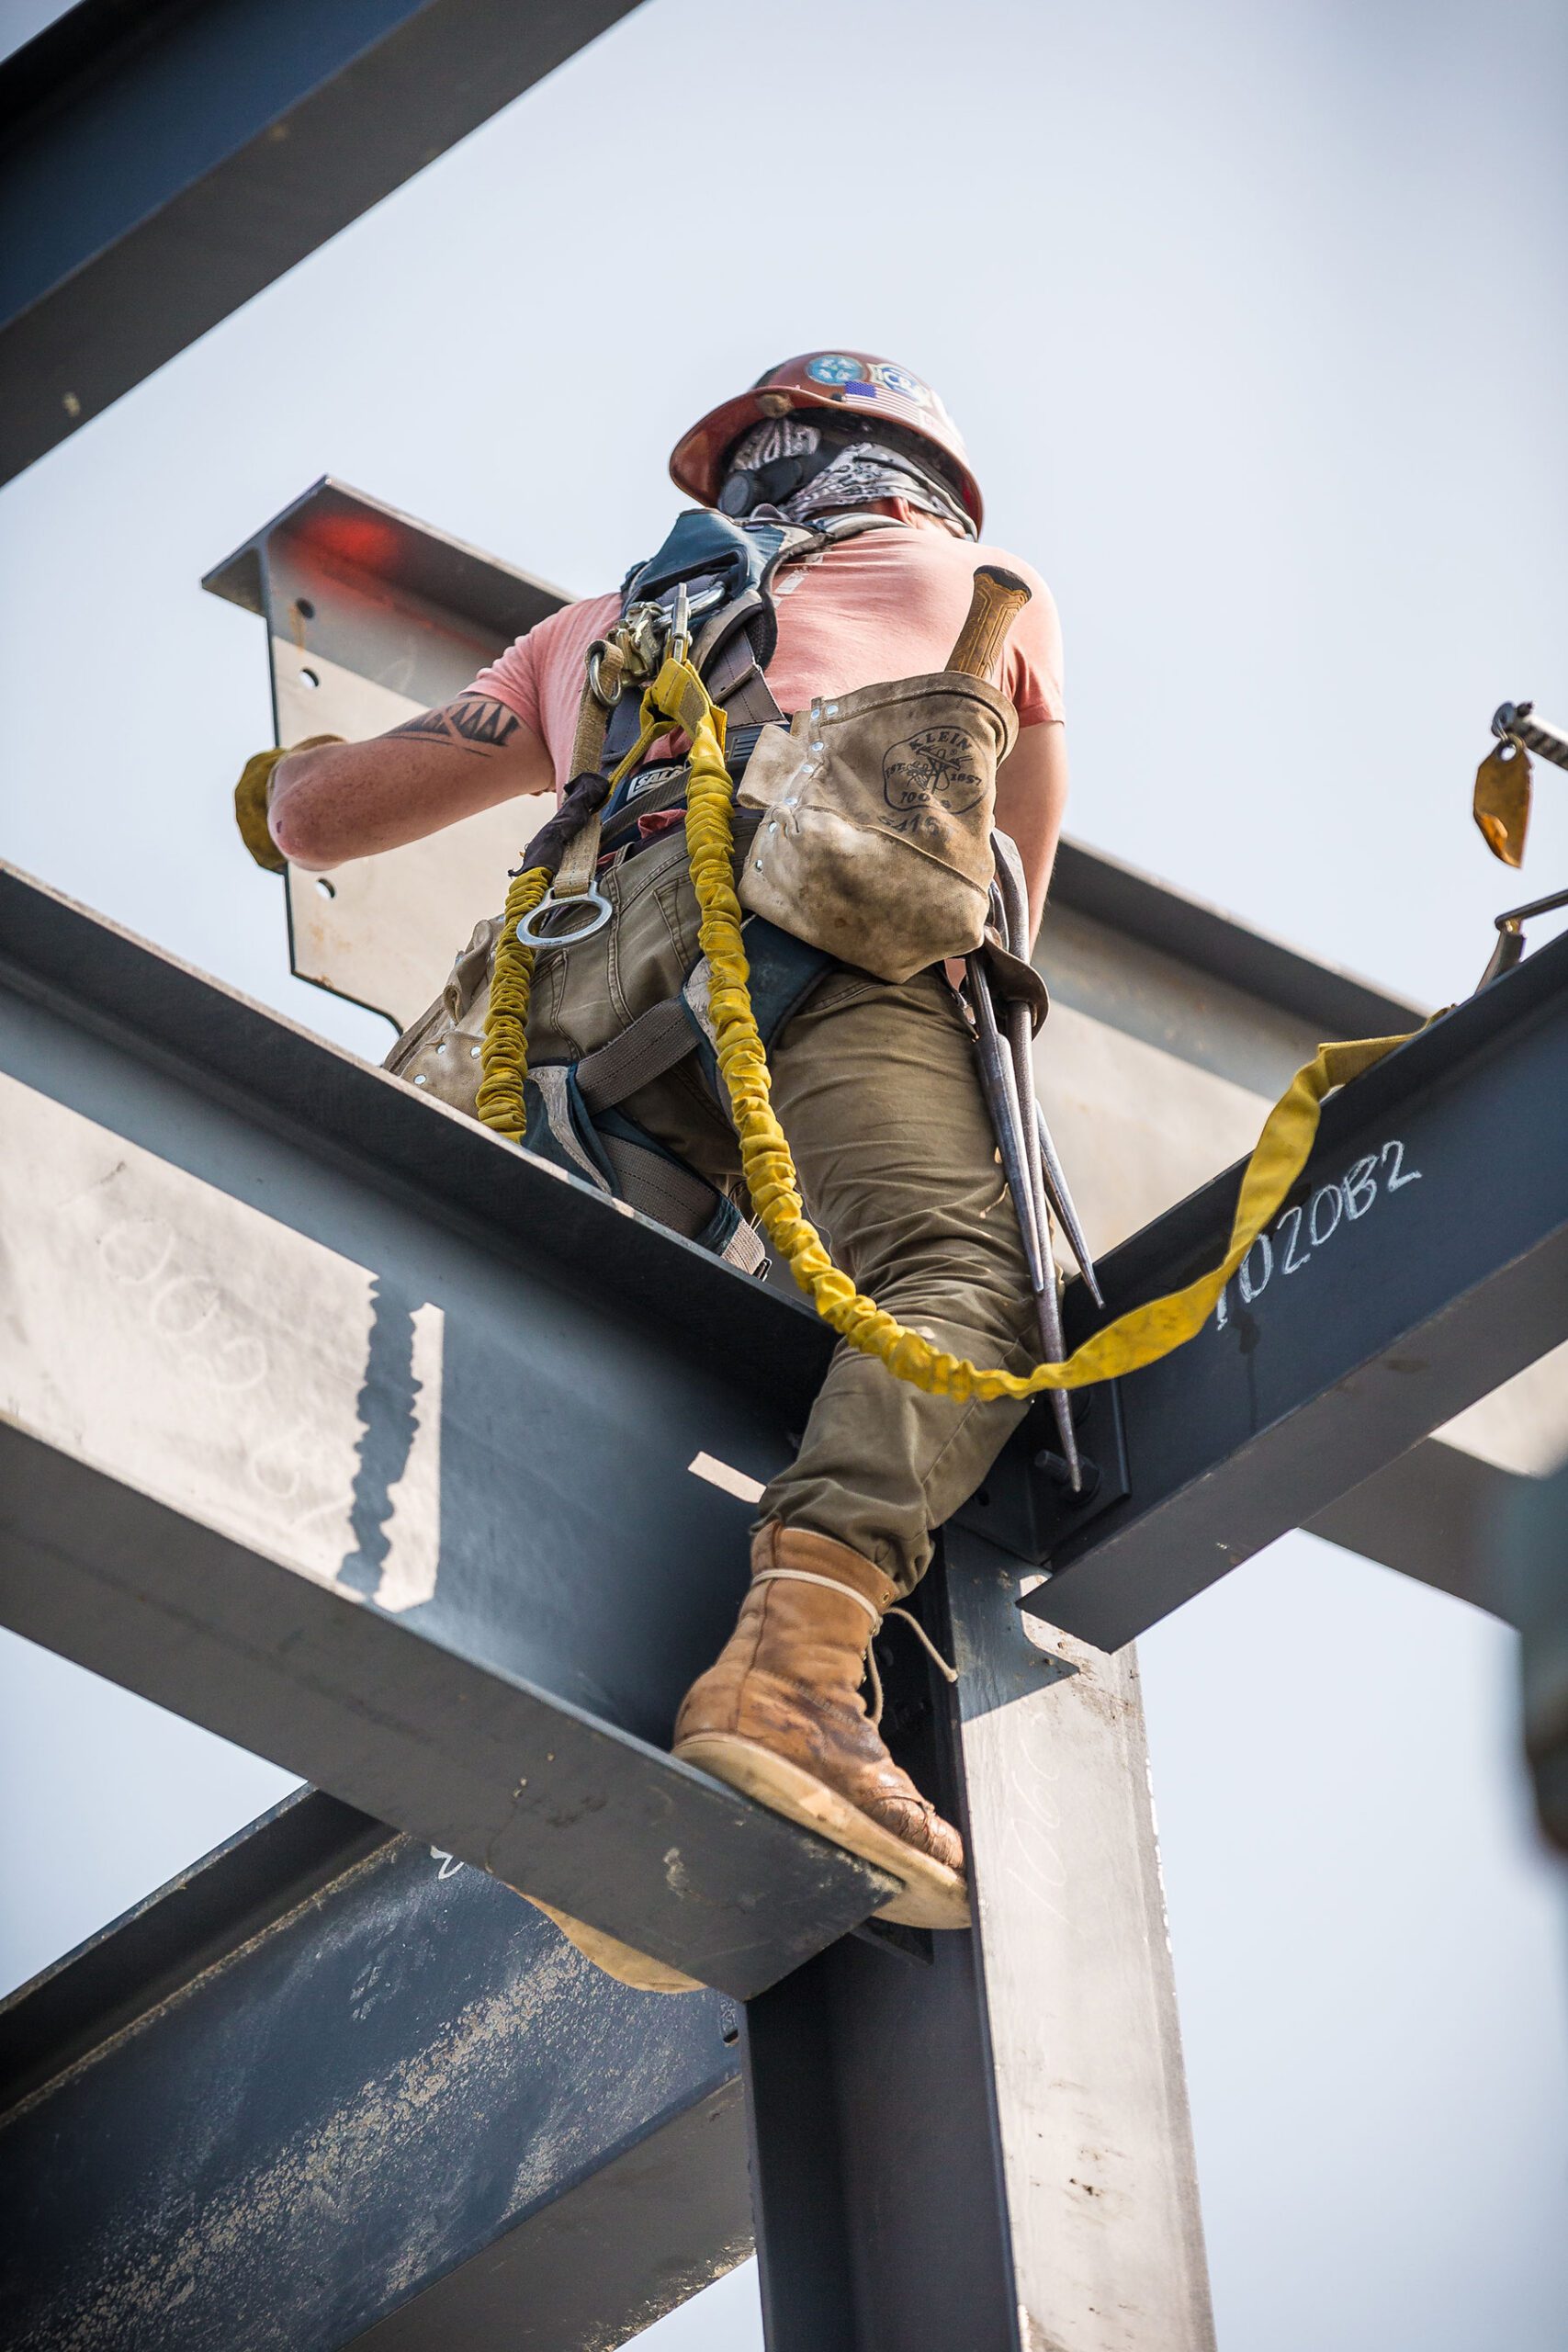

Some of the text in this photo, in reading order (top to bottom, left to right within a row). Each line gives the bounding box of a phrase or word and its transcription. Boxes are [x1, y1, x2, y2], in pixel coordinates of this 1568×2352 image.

[908, 731, 973, 752] KLEIN
[950, 773, 983, 786] 1857
[900, 791, 953, 809] TOOS
